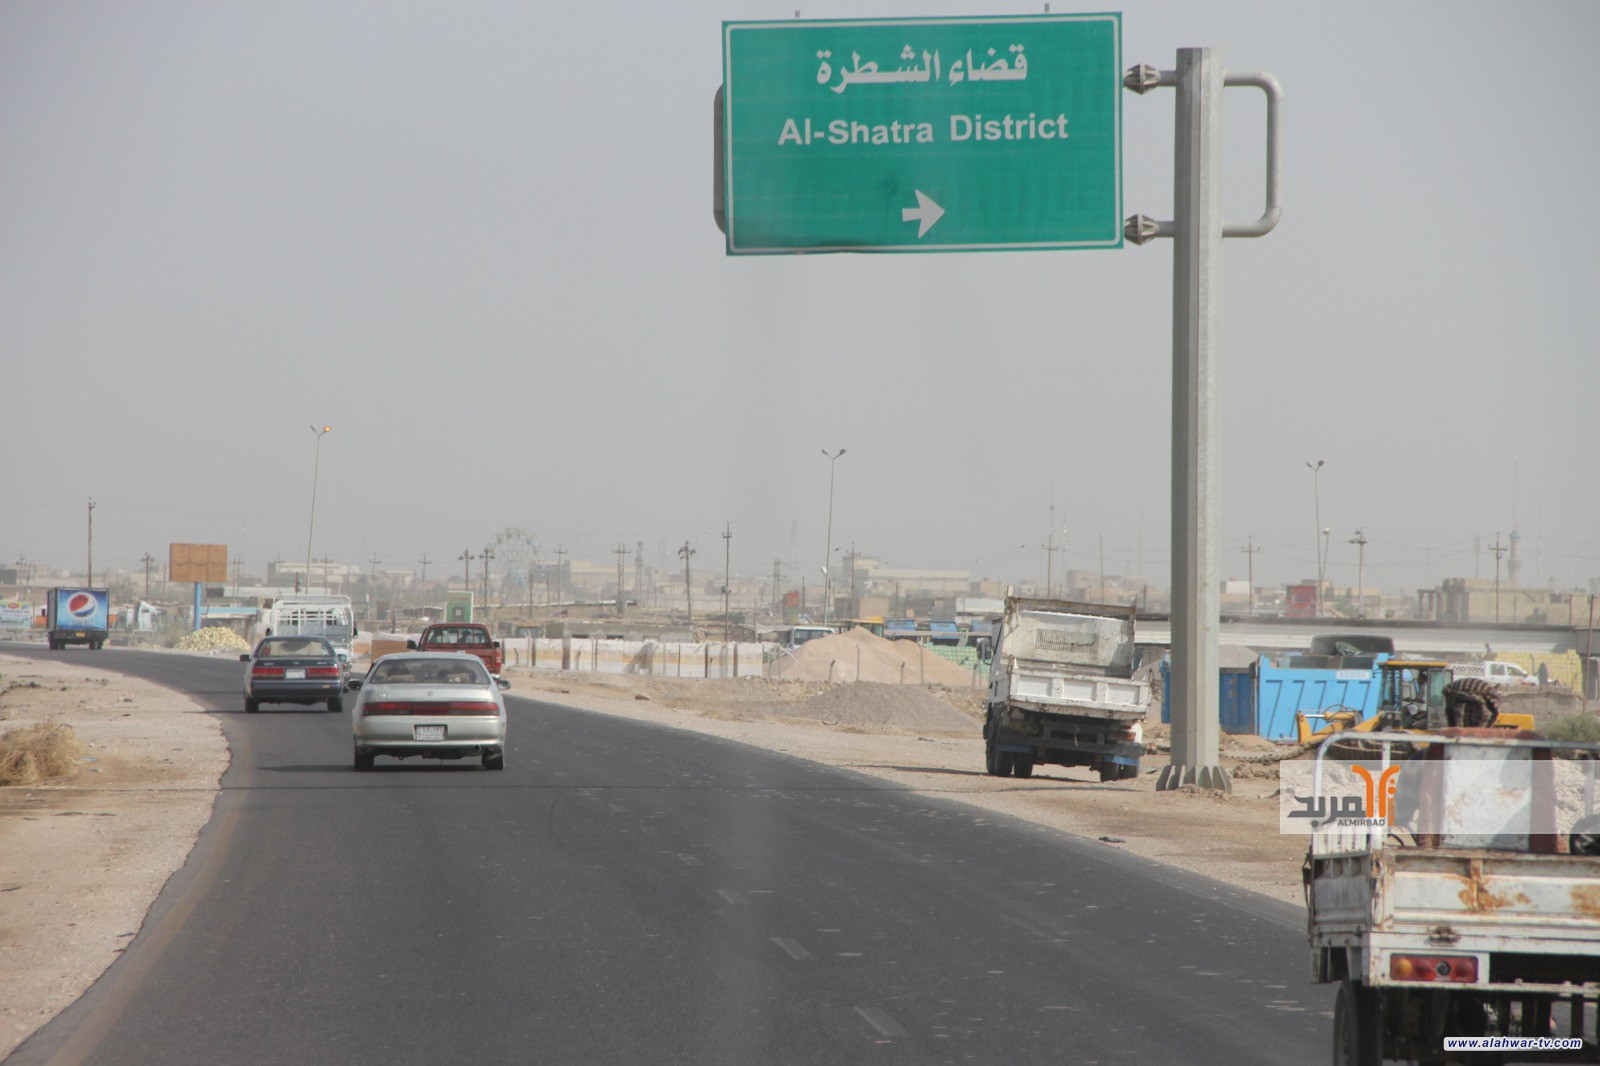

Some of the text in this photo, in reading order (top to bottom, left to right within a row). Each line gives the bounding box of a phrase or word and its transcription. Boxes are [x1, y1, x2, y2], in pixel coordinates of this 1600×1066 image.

[816, 44, 1028, 94] قضاء الشطرة
[777, 112, 1069, 146] Al-Shatra District
